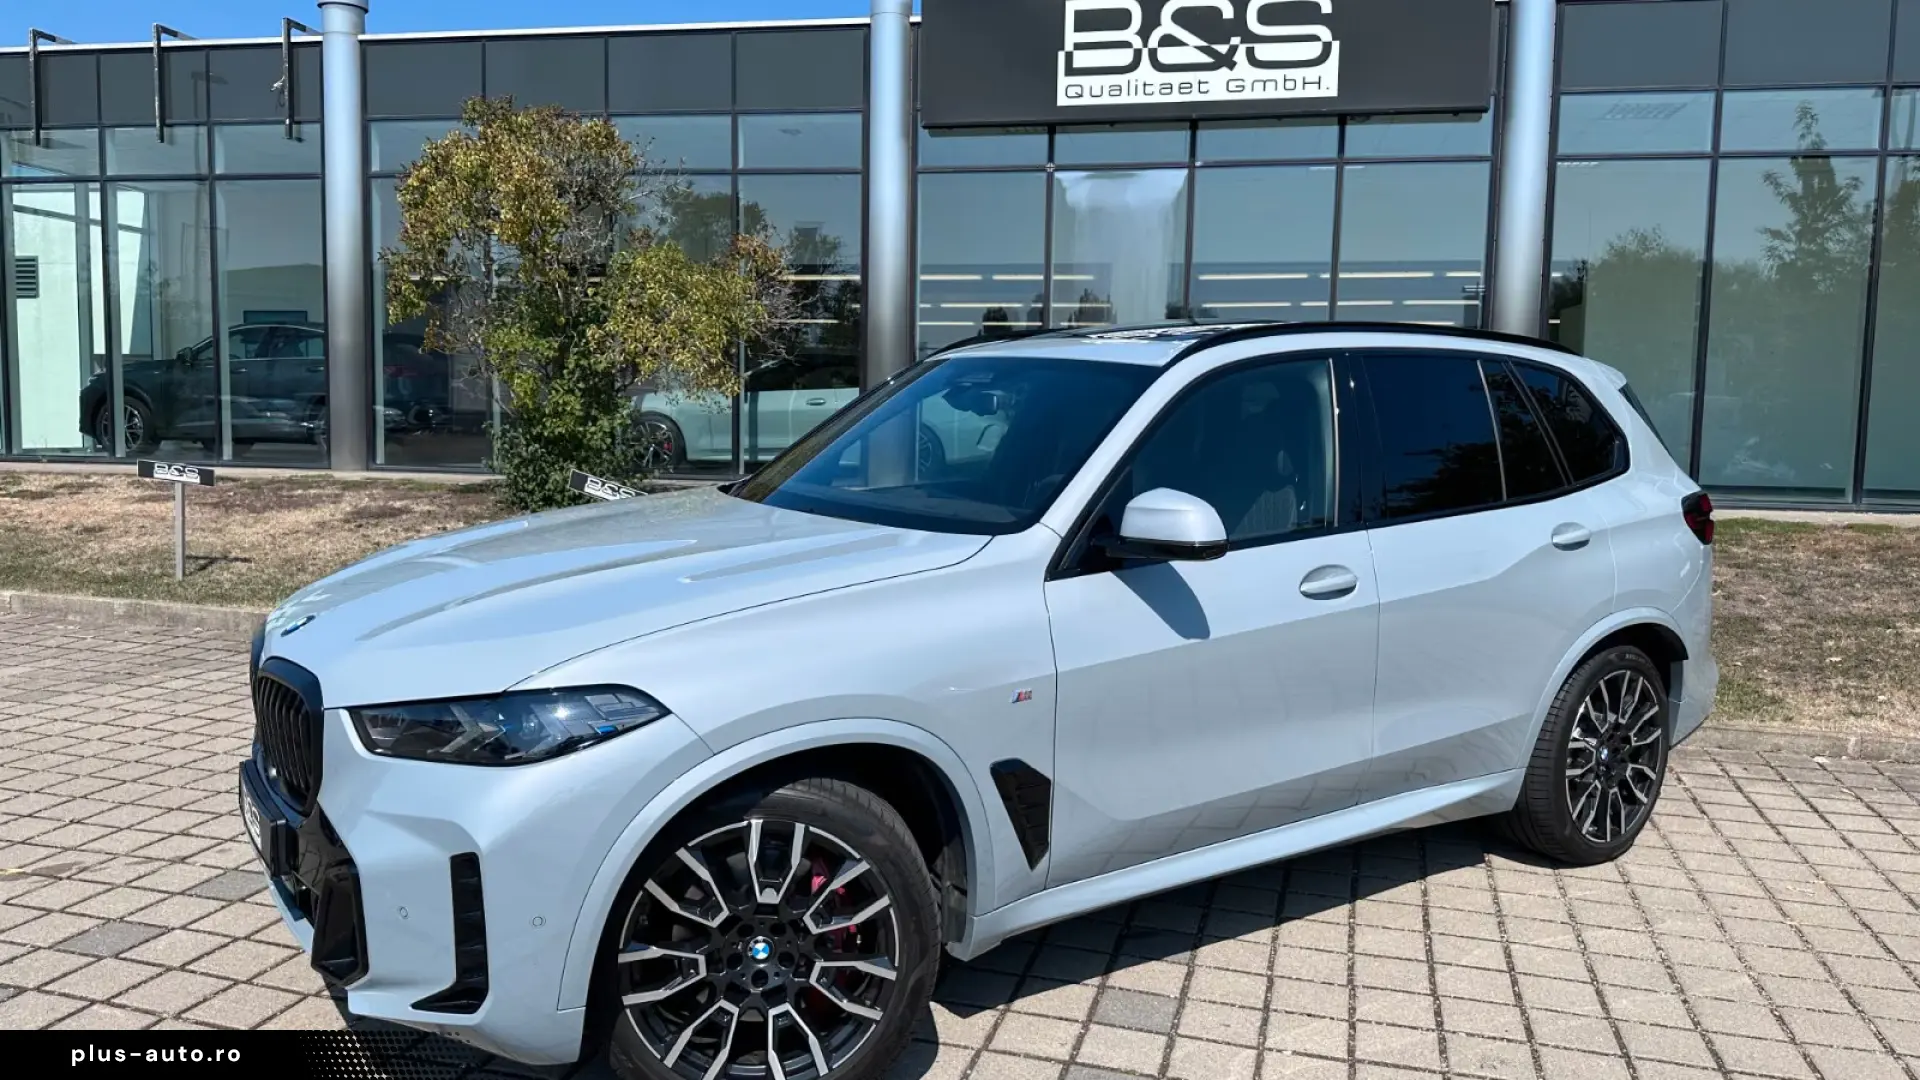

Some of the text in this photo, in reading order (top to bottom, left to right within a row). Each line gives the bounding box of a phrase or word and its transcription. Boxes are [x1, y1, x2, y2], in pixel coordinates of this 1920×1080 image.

[1064, 0, 1333, 77] B&S
[1064, 74, 1330, 99] Qualitaet GmbH.
[153, 463, 199, 480] B&S
